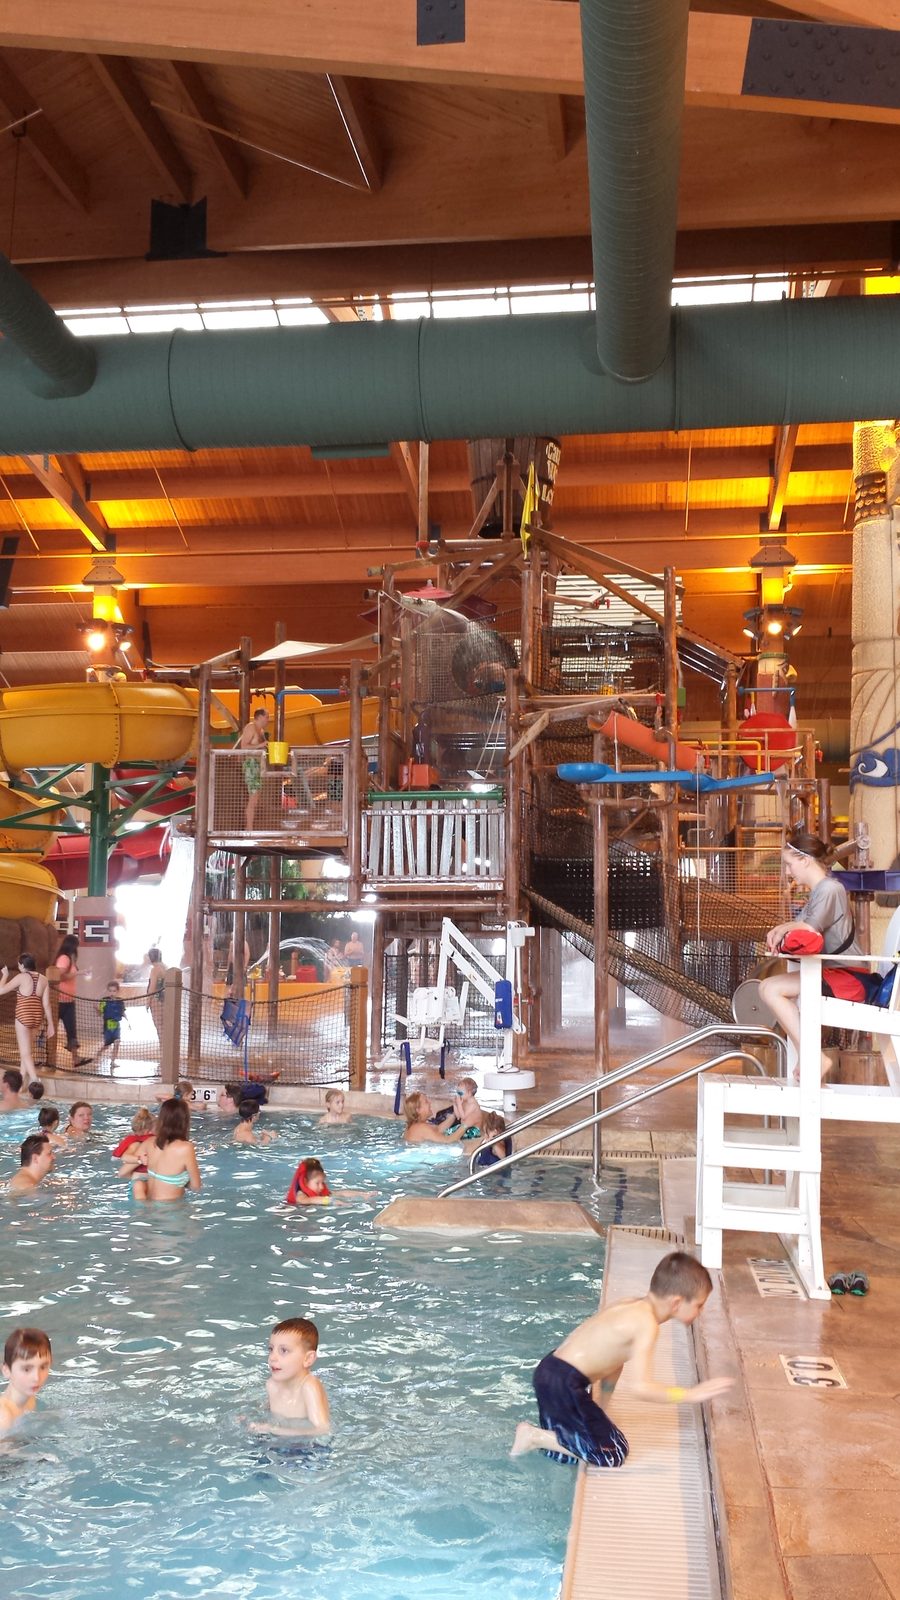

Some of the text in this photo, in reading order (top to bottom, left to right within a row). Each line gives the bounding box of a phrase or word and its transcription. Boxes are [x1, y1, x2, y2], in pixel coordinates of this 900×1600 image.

[190, 1090, 196, 1100] 3
[204, 1090, 210, 1100] 6
[793, 1377, 841, 1387] 3
